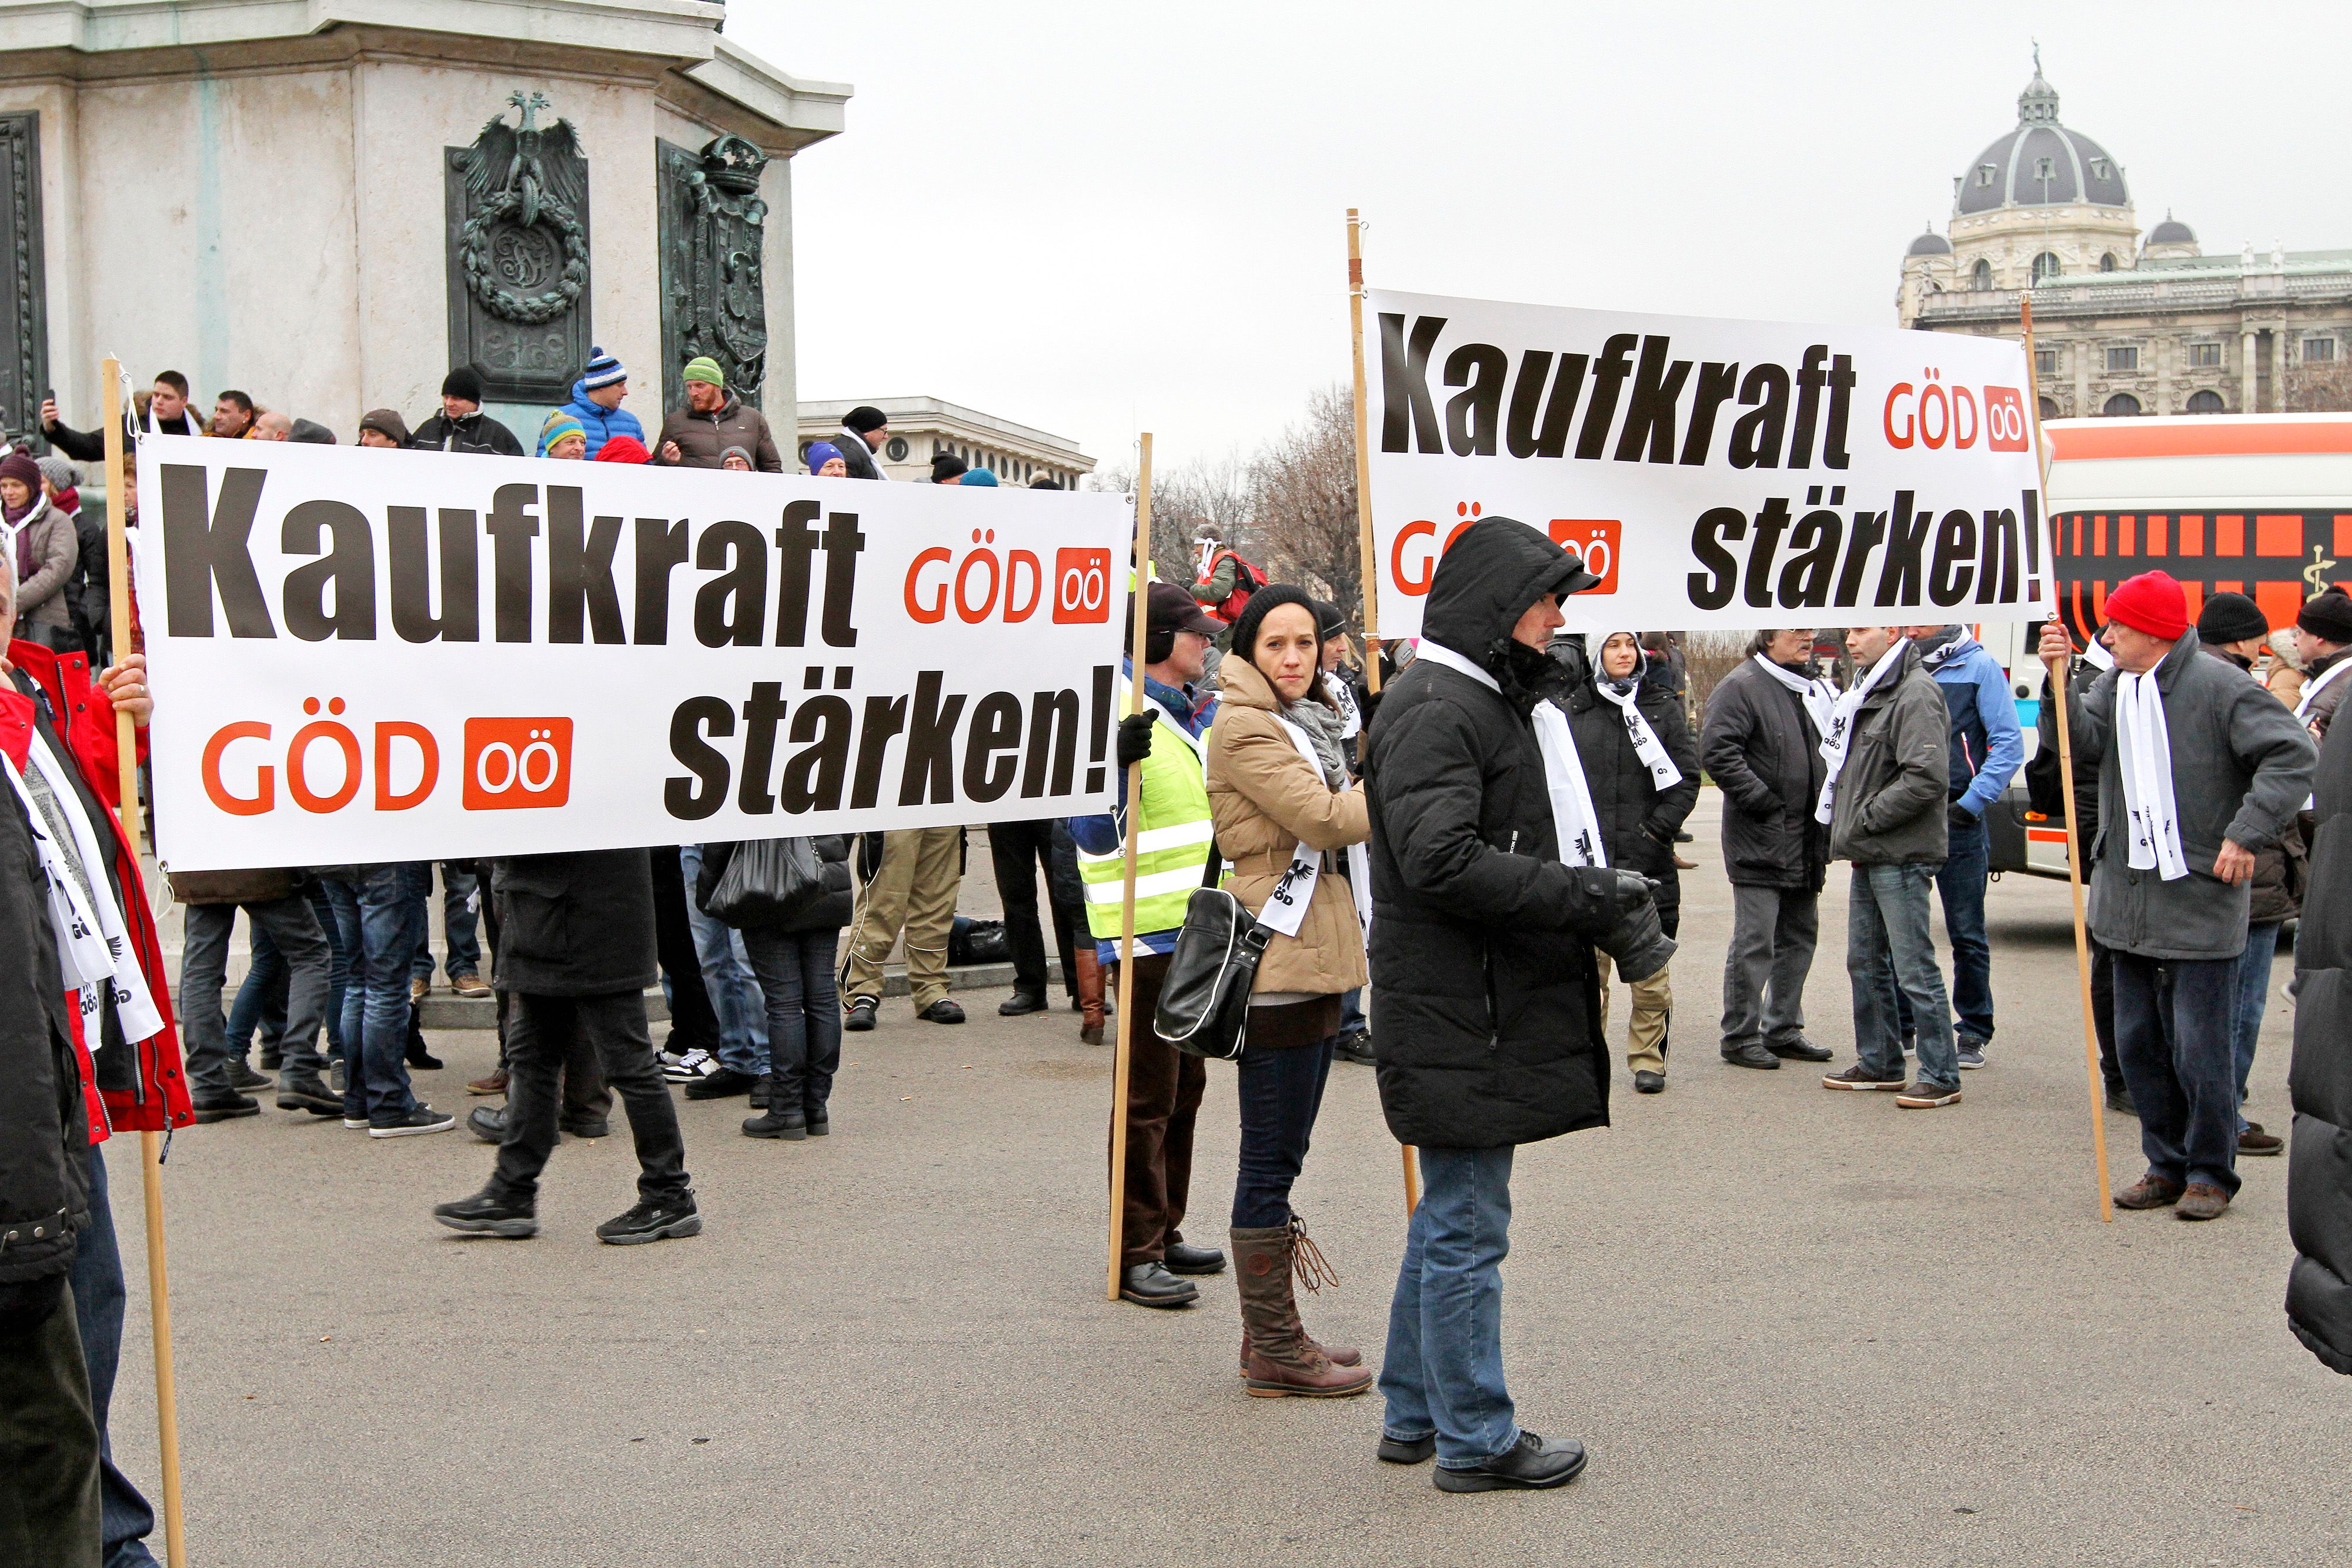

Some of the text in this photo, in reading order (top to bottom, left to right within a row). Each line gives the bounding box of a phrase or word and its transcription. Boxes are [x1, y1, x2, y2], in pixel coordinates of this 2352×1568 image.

[1378, 313, 1856, 470] Kaufkraft
[1884, 367, 1978, 450] GÖD
[161, 464, 866, 648] Kaufkraft
[904, 529, 1042, 624] GÖD
[1687, 486, 2041, 611] stärken!
[202, 697, 439, 816] GÖD
[664, 666, 1114, 821] stärken!
[1271, 886, 1293, 906] ÖD
